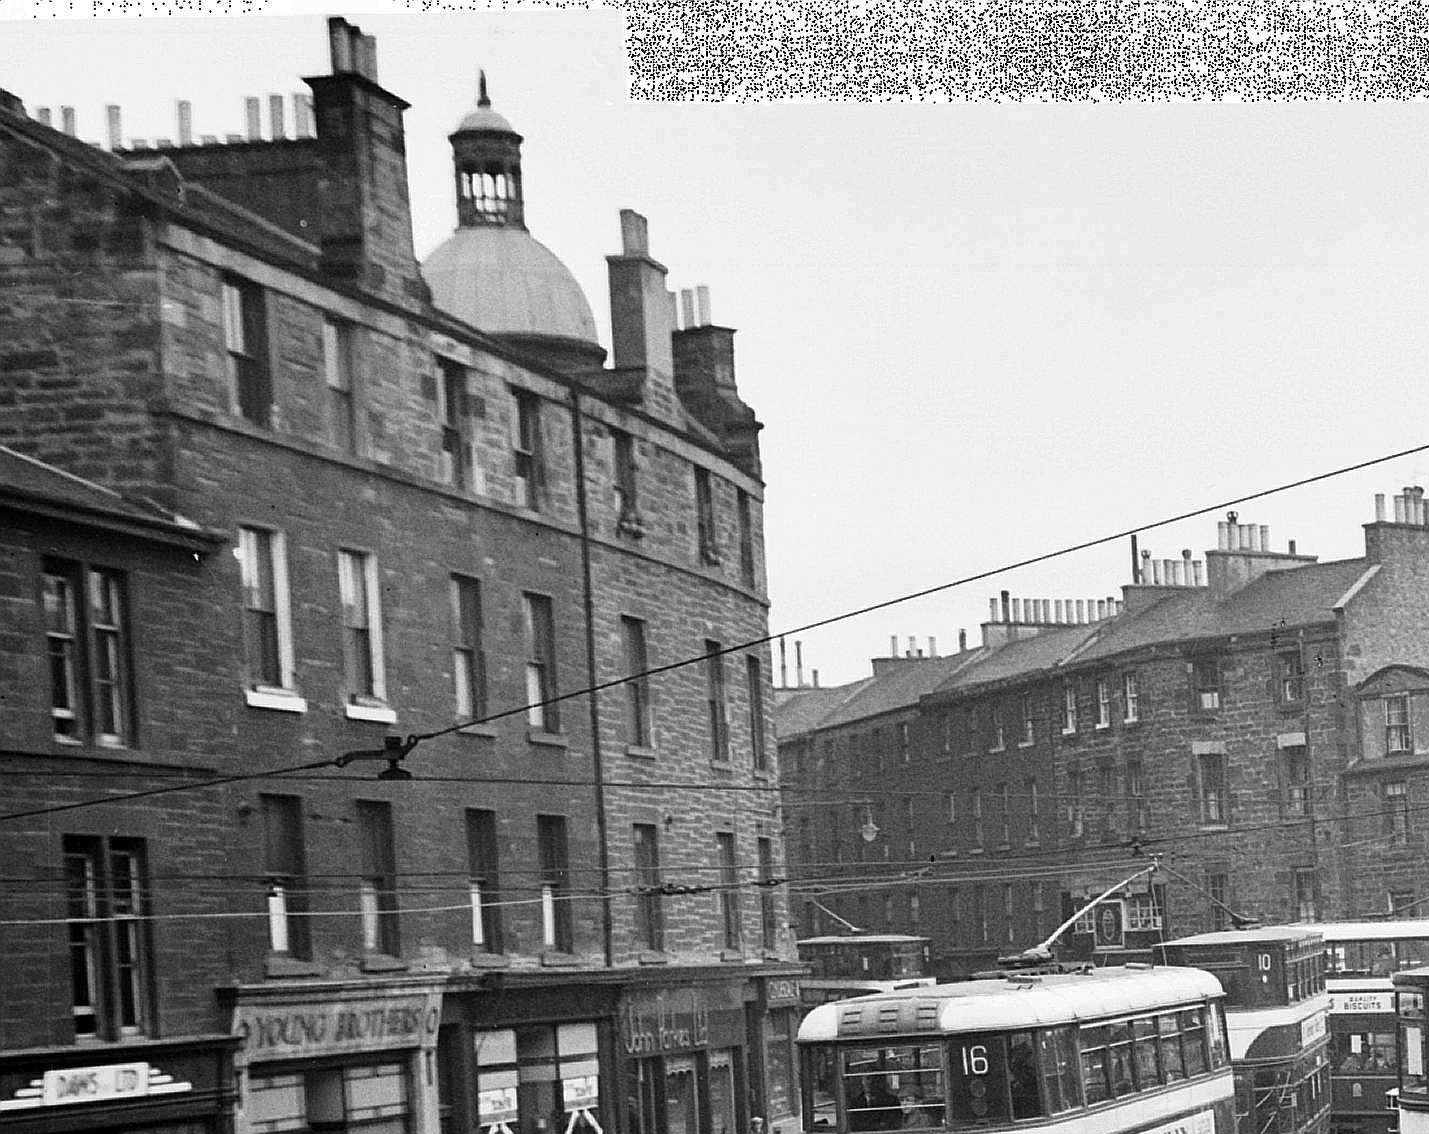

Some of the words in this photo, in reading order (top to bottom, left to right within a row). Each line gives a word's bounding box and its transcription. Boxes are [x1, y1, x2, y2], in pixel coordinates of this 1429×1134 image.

[1258, 953, 1271, 970] 10
[1343, 1001, 1382, 1010] BISCUITS
[254, 1012, 328, 1048] YOUNG
[334, 1007, 423, 1042] BROTHERS
[962, 1045, 989, 1076] 16
